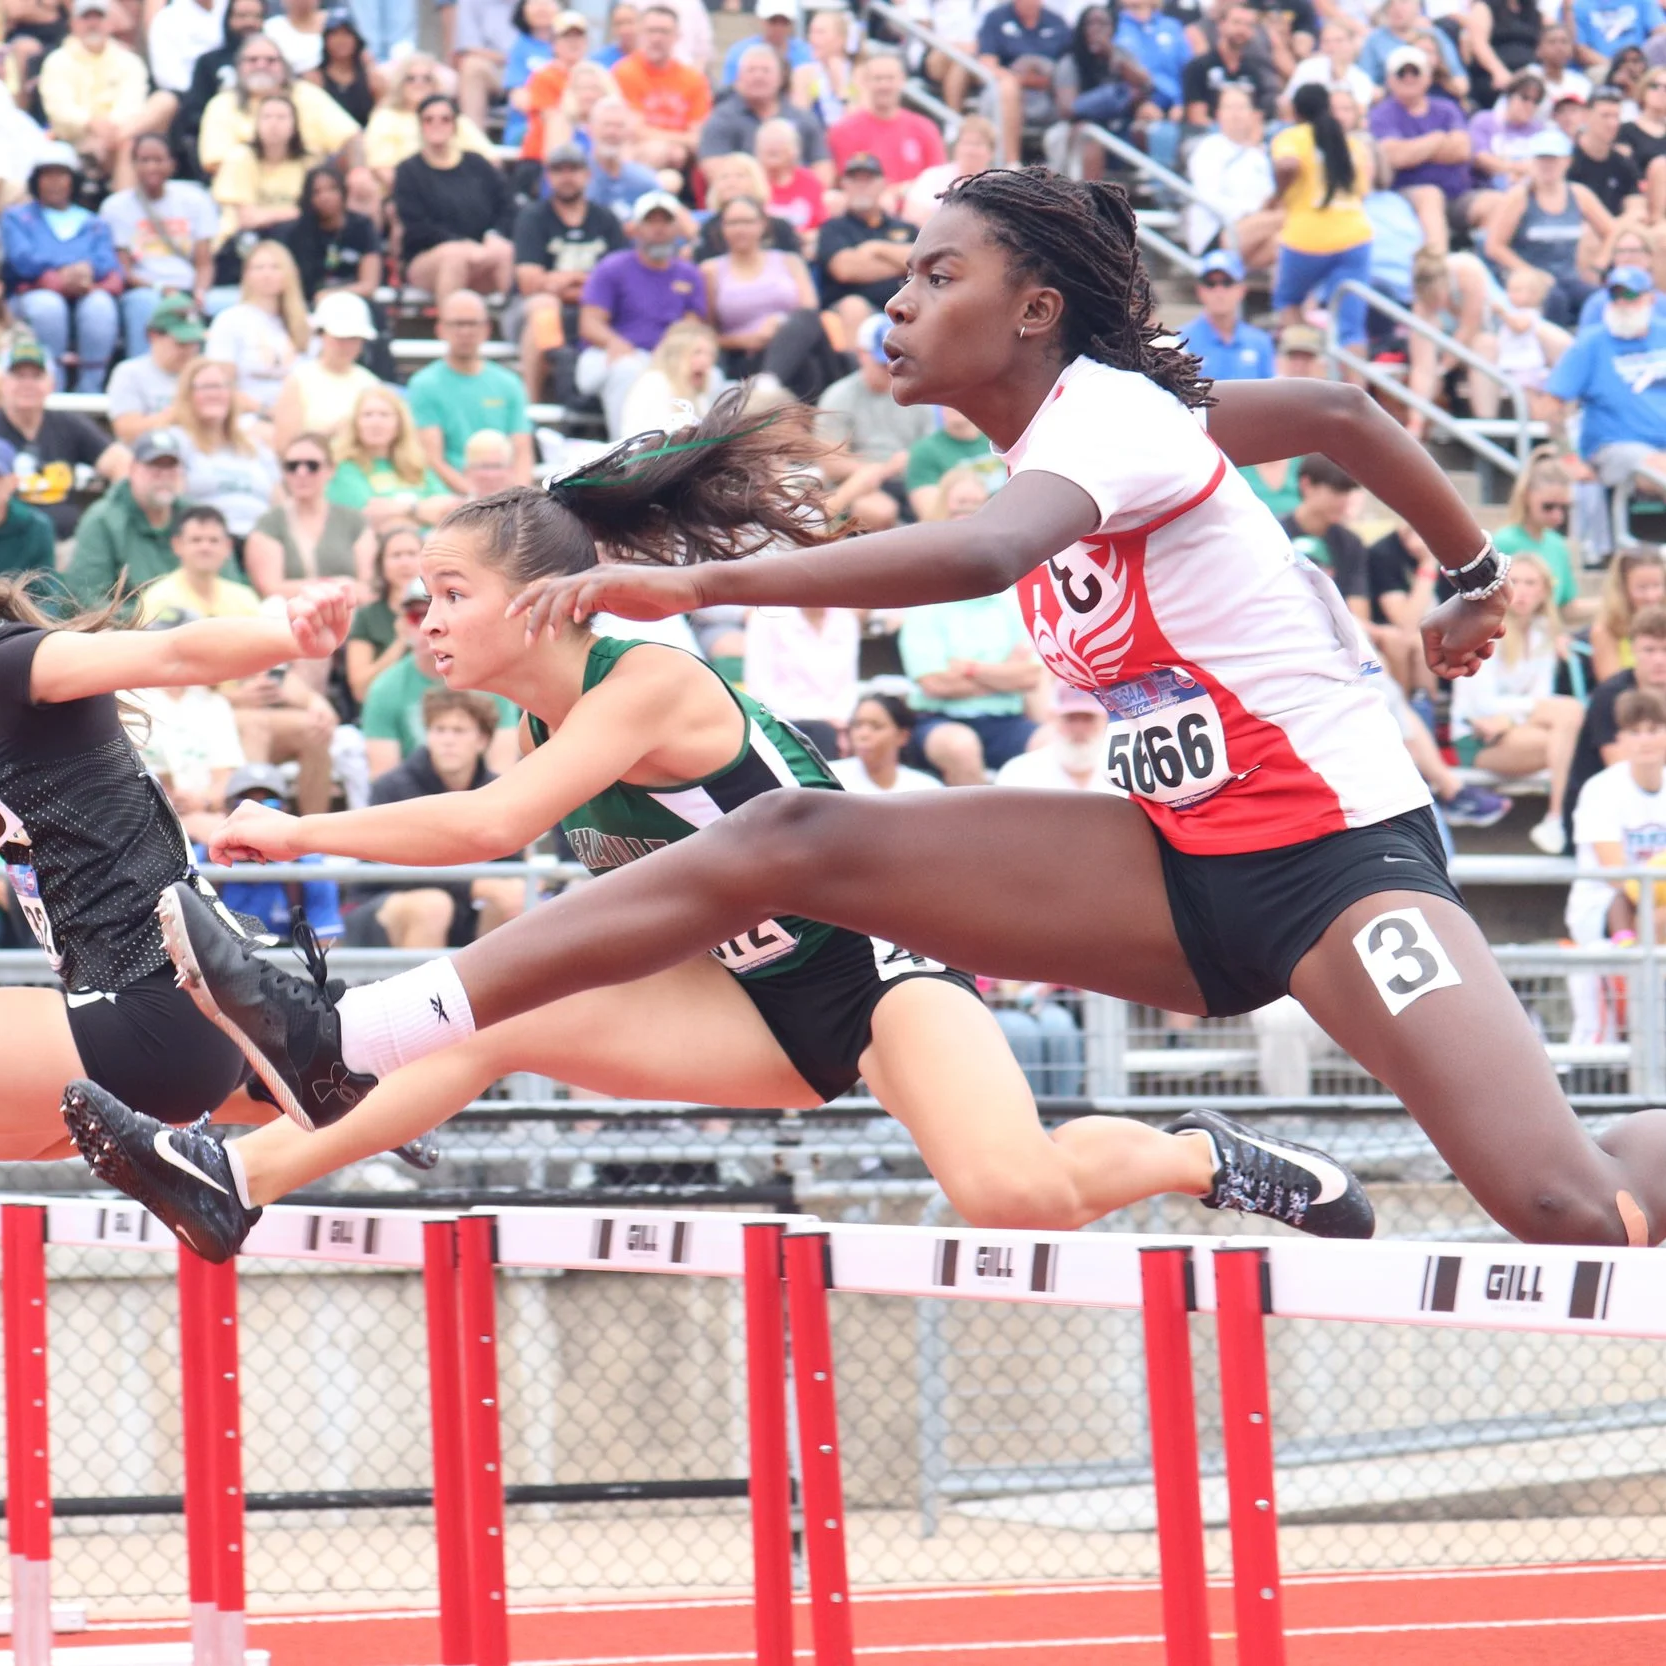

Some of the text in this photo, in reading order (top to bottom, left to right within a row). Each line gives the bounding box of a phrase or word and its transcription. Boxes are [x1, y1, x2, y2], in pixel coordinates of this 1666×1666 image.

[1107, 713, 1215, 794] 5666
[1368, 918, 1439, 995] 3
[976, 1247, 1014, 1278] GILL
[1486, 1265, 1544, 1302] GILL
